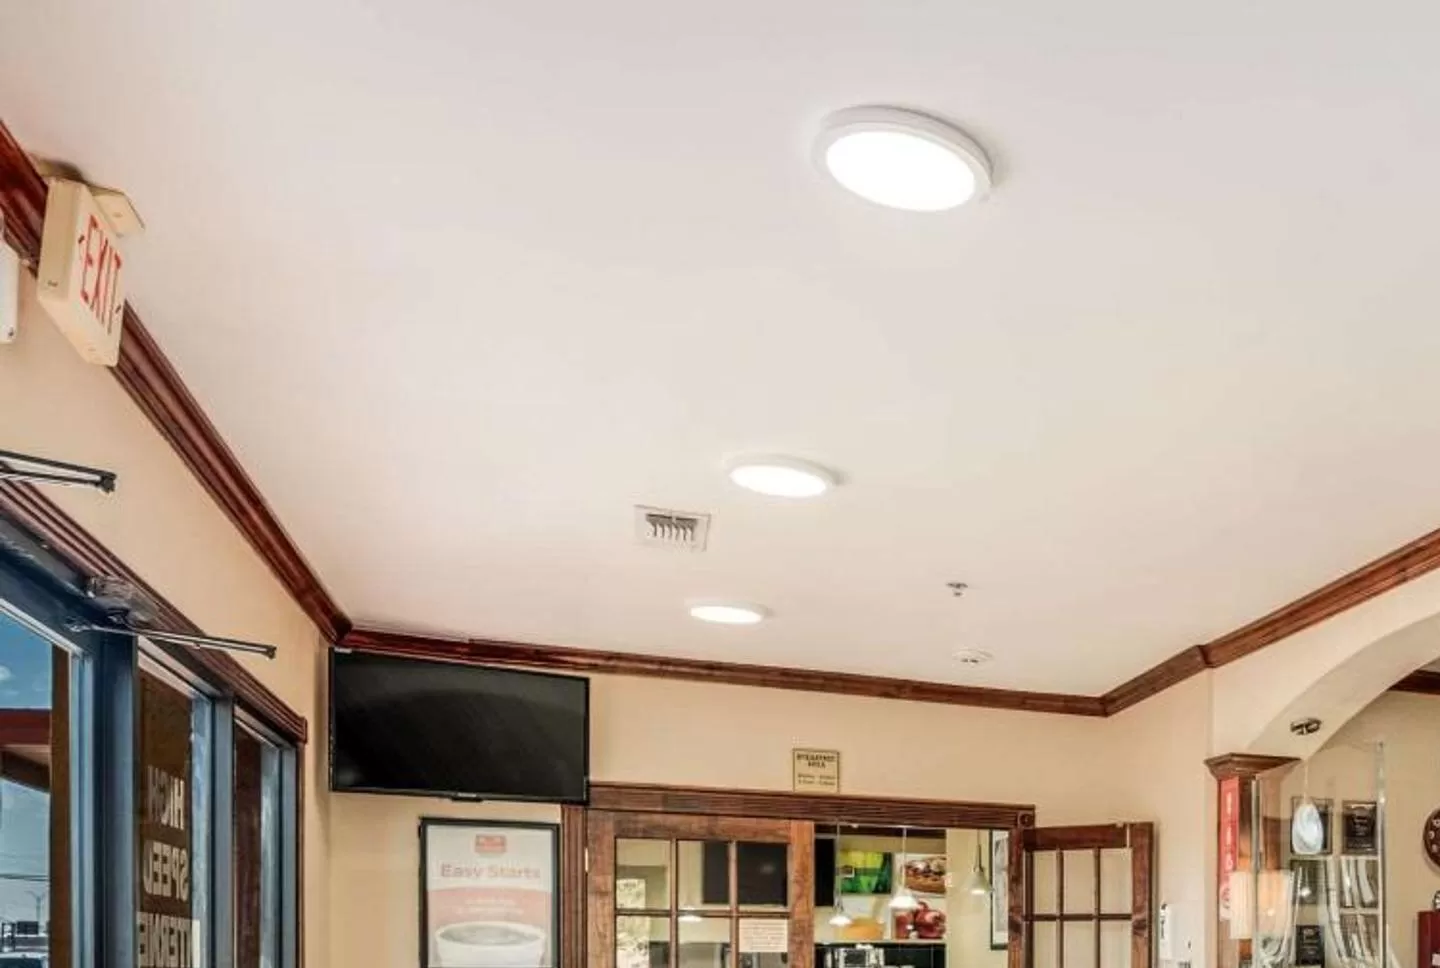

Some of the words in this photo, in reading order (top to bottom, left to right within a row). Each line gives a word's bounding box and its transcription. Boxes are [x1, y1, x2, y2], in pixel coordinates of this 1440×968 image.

[80, 214, 122, 335] EXIT
[440, 862, 482, 881] Easy
[487, 861, 541, 879] Starts
